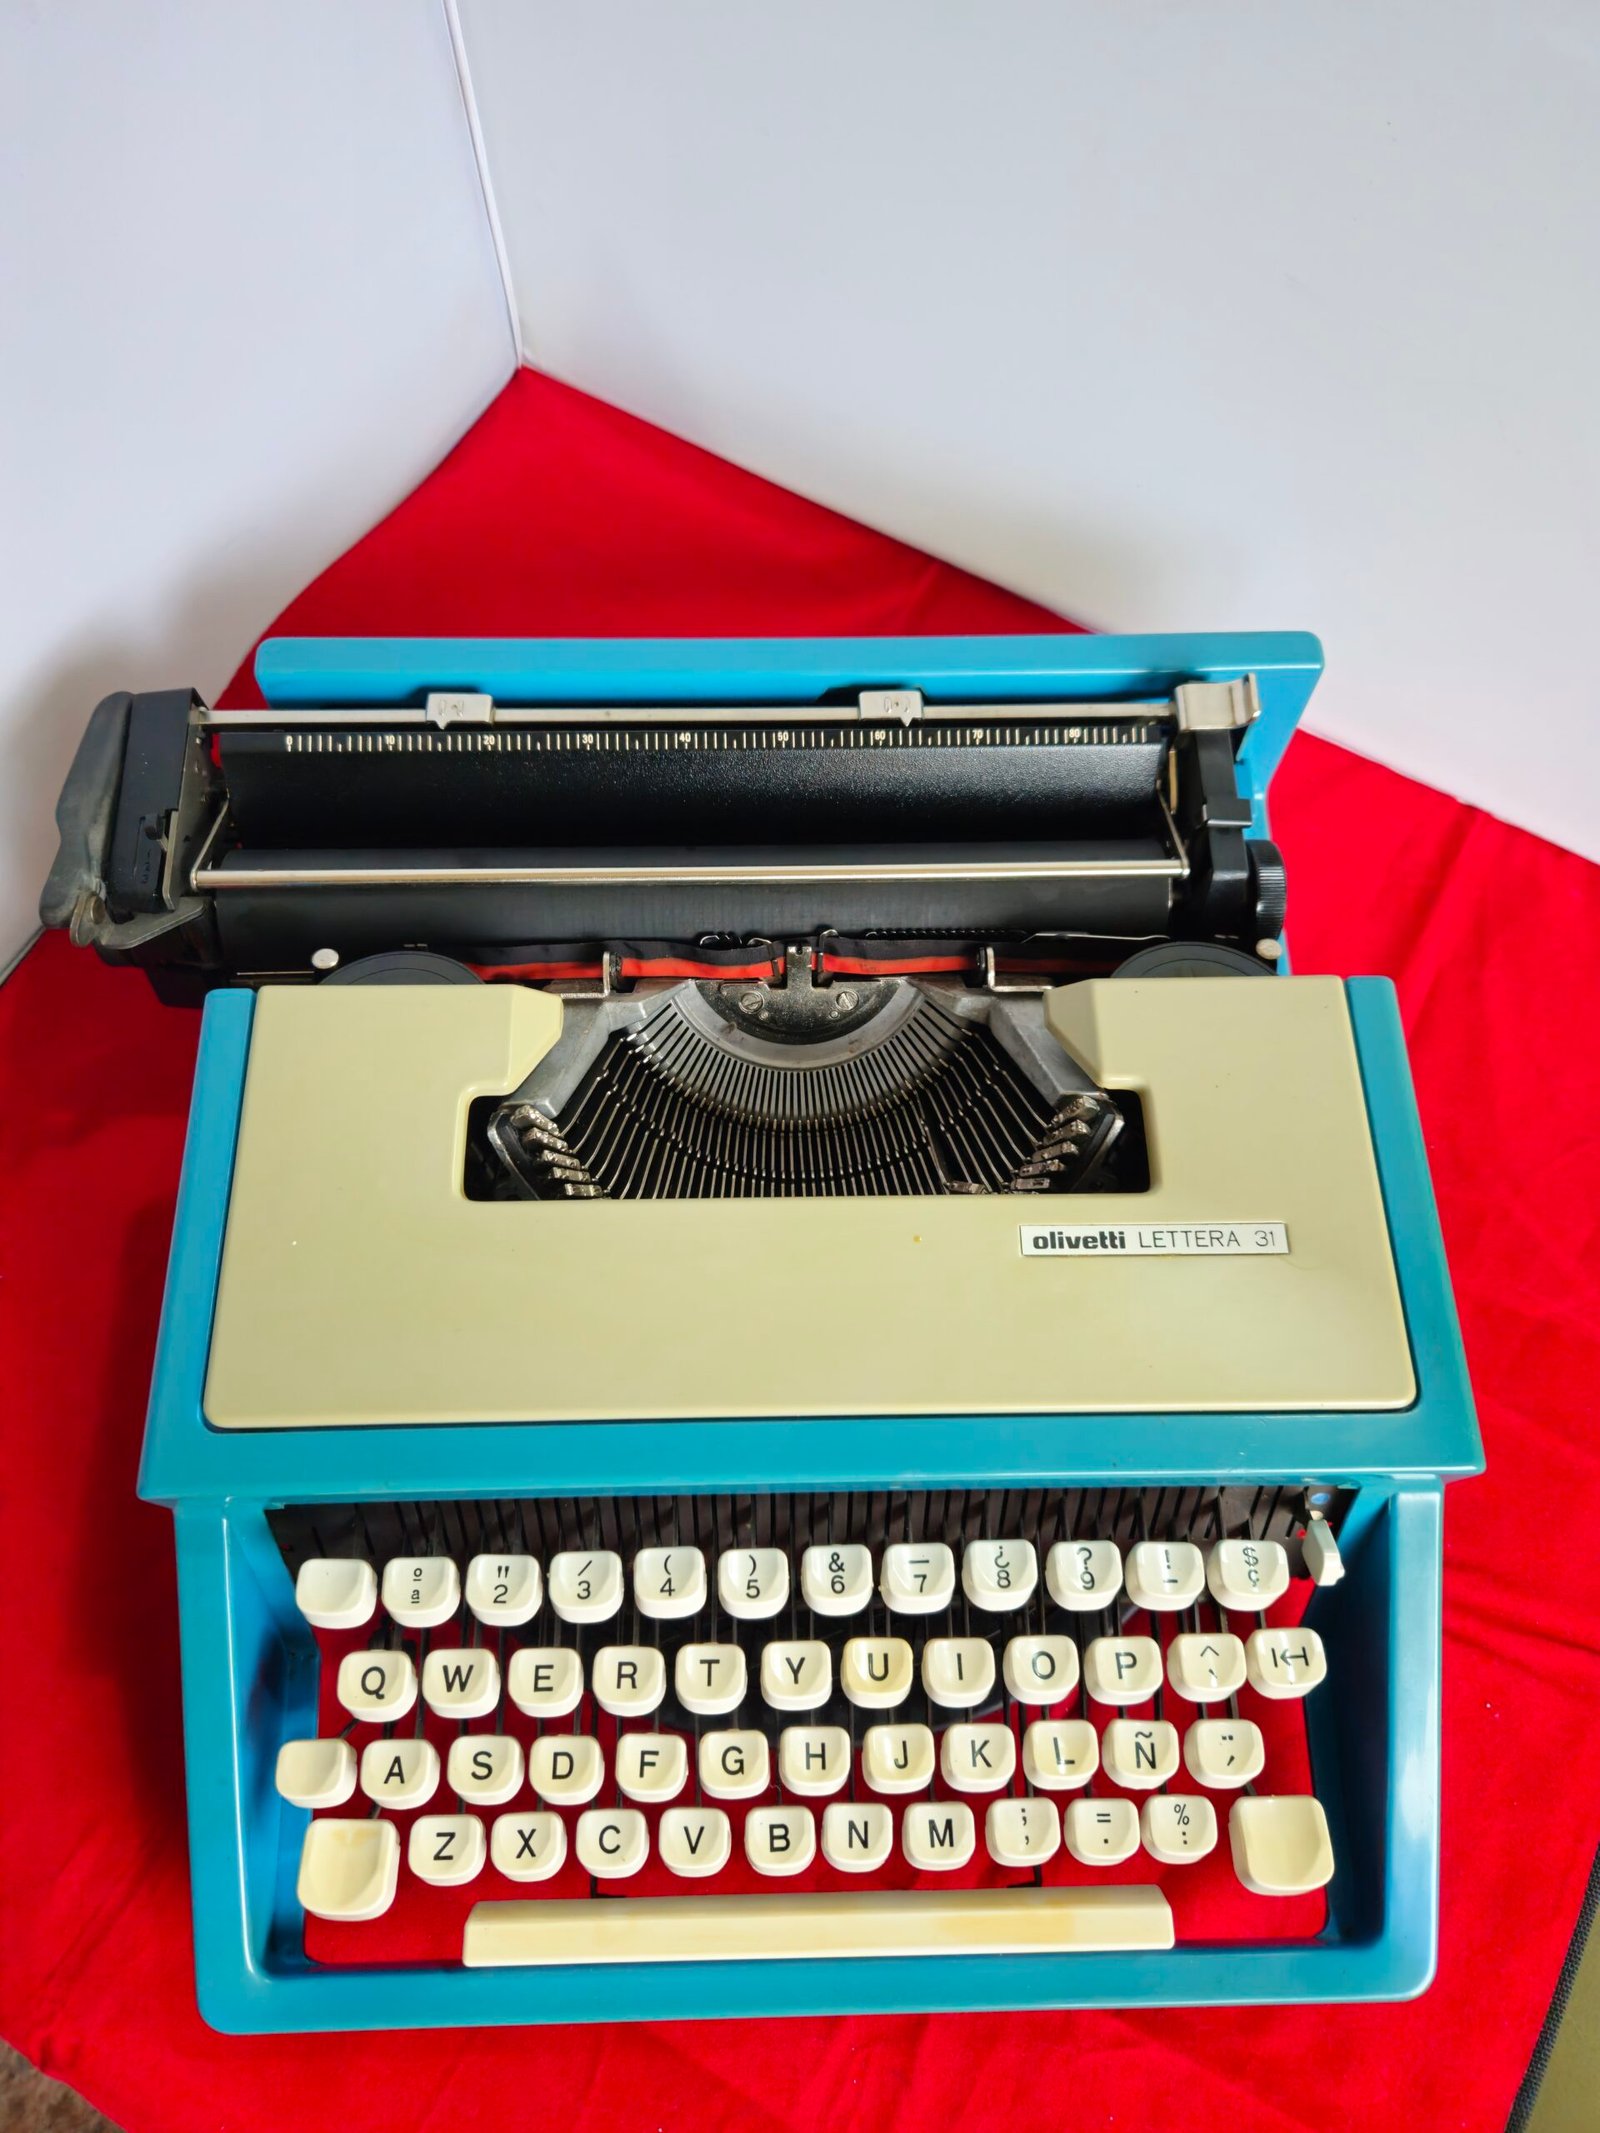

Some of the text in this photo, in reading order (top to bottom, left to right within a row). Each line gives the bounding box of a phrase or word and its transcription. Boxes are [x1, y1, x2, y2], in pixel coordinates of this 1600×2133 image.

[286, 728, 1081, 745] 0 10 20 30 40 50 60 70 80
[1032, 1230, 1275, 1250] olivetti LETTERA 31
[664, 1555, 672, 1575] (
[749, 1555, 757, 1576] )
[828, 1552, 846, 1572] &
[1076, 1546, 1092, 1572] ?
[1164, 1549, 1172, 1570] !
[1242, 1546, 1259, 1567] $
[577, 1580, 591, 1600] 3
[660, 1578, 676, 1597] 4
[746, 1579, 760, 1599] 5
[831, 1575, 845, 1594] 6
[913, 1574, 927, 1593] 7
[997, 1569, 1011, 1589] 8
[1080, 1571, 1095, 1590] 9
[493, 1585, 508, 1604] 2
[442, 1664, 474, 1693] W
[533, 1664, 555, 1692] E
[616, 1661, 638, 1689] R
[699, 1659, 720, 1687] T
[785, 1656, 806, 1685] Y
[867, 1653, 889, 1682] U
[956, 1653, 964, 1681] I
[1031, 1650, 1056, 1680] O
[1115, 1652, 1138, 1680] P
[361, 1666, 386, 1700] Q
[639, 1750, 660, 1778] F
[721, 1745, 745, 1776] G
[805, 1741, 827, 1771] H
[893, 1740, 908, 1769] J
[970, 1739, 992, 1768] K
[1053, 1736, 1076, 1765] L
[1134, 1730, 1157, 1770] Ñ
[383, 1755, 406, 1785] A
[471, 1750, 494, 1780] S
[551, 1751, 575, 1780] D
[1096, 1812, 1112, 1823] =
[1173, 1803, 1190, 1826] %
[433, 1832, 456, 1861] Z
[515, 1828, 537, 1859] X
[598, 1824, 621, 1854] C
[683, 1825, 705, 1855] V
[769, 1823, 791, 1853] B
[848, 1820, 869, 1850] N
[928, 1818, 955, 1848] M
